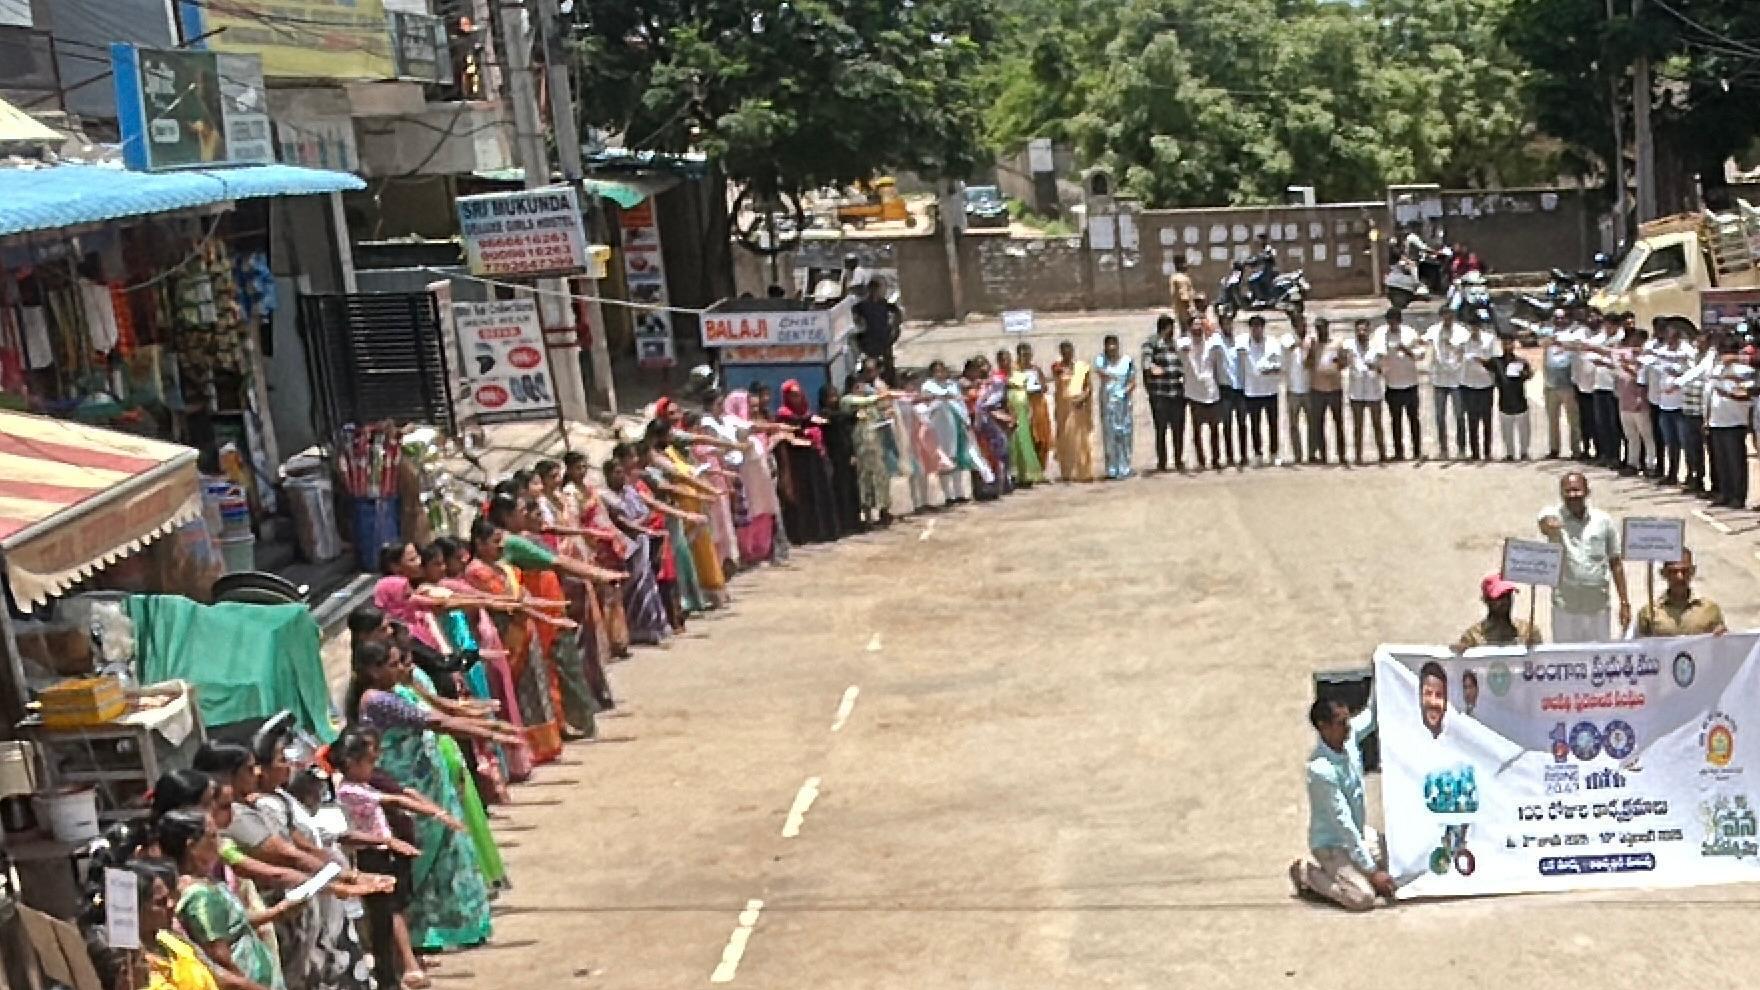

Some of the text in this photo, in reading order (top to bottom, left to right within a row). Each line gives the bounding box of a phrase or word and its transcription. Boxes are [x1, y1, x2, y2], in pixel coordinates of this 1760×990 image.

[463, 195, 571, 219] SRI MUKUNDA
[705, 318, 769, 341] BALAJI
[1522, 659, 1588, 682] తెలంగాణ
